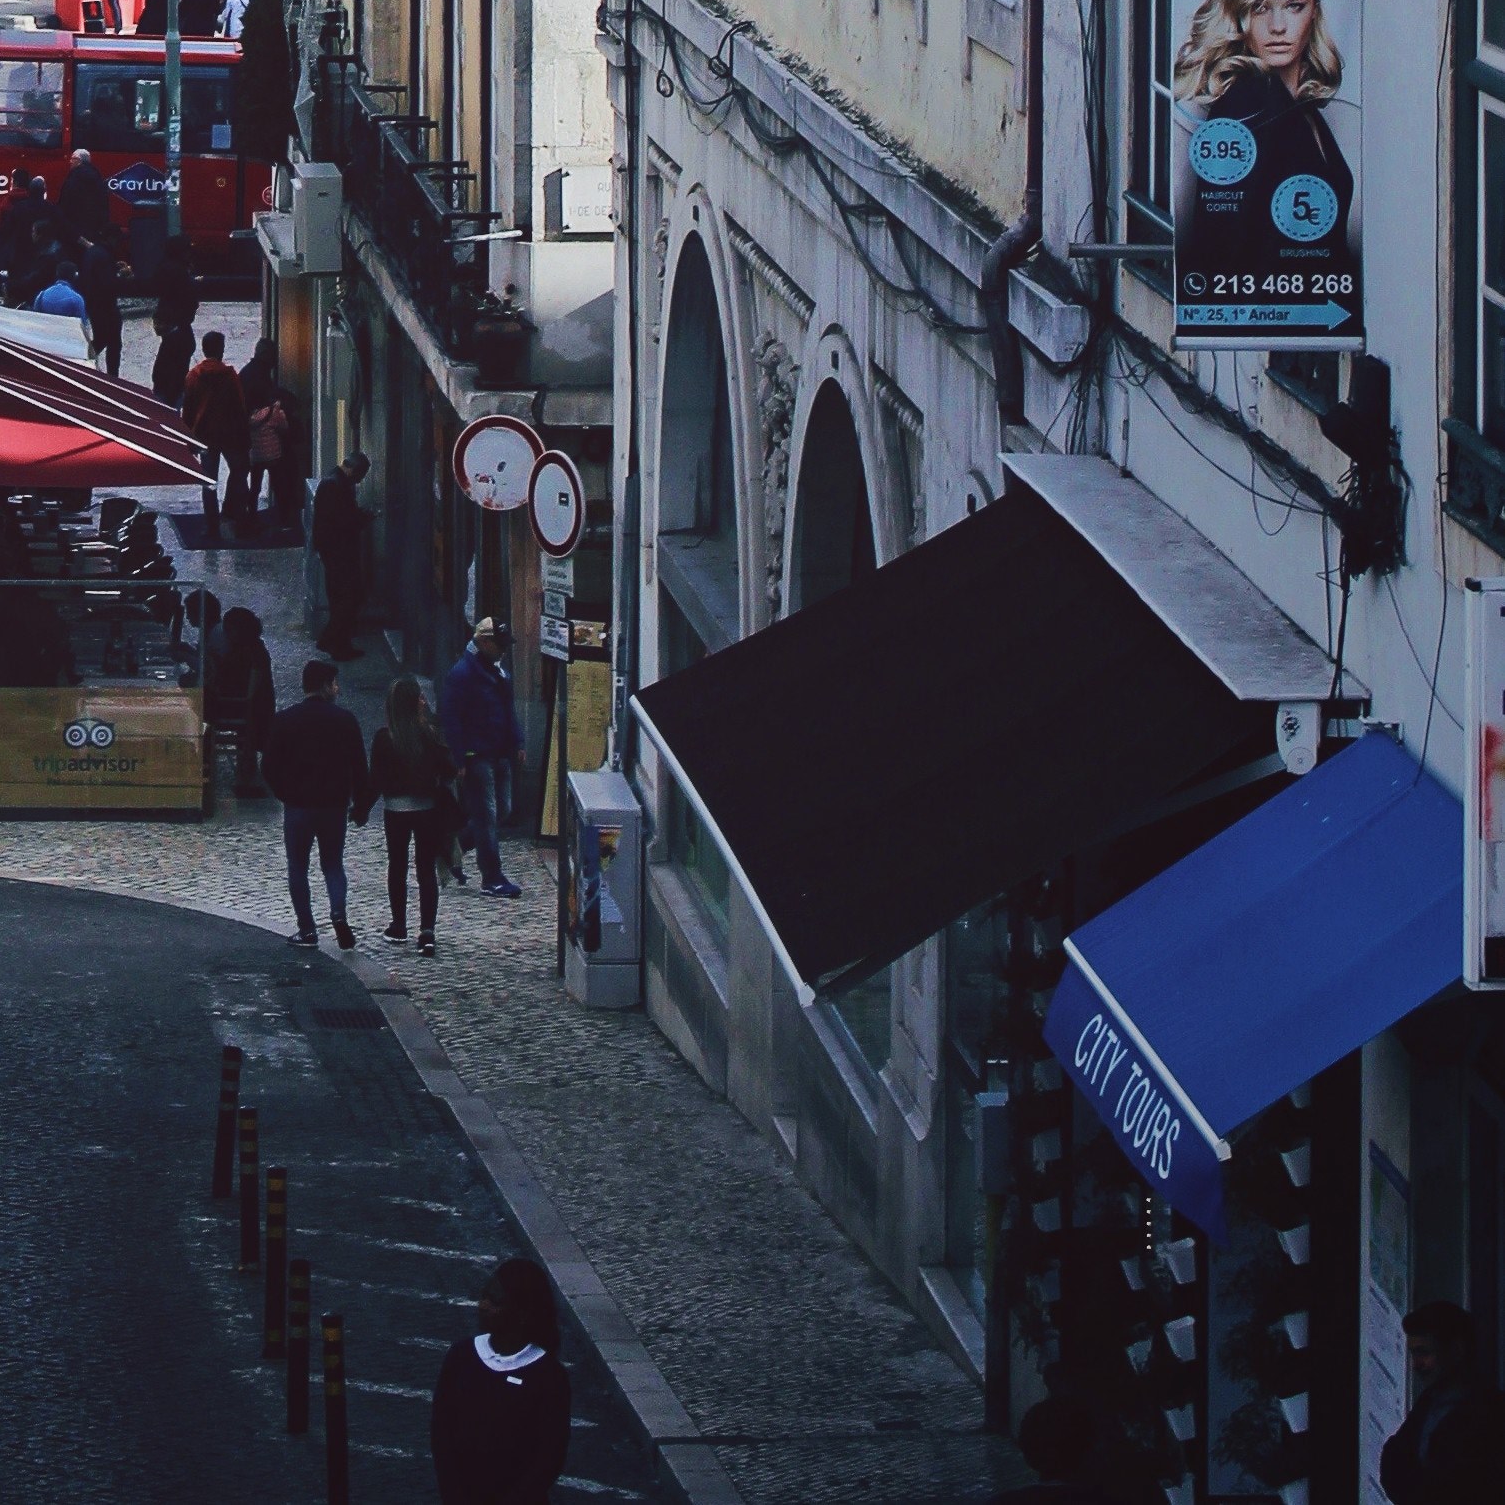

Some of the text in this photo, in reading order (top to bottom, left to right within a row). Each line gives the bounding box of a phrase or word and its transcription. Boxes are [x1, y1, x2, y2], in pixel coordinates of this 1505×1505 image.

[1199, 140, 1246, 162] 5.95€
[1200, 191, 1244, 200] HAIRCUT
[1206, 203, 1239, 212] CORTE
[1279, 248, 1331, 258] BRUSHING
[1213, 274, 1353, 295] 213 468 268
[1207, 309, 1229, 323] 25,
[1248, 308, 1291, 321] Andar
[34, 754, 140, 773] tripadvisor
[1074, 1013, 1180, 1179] CITY TOURS
